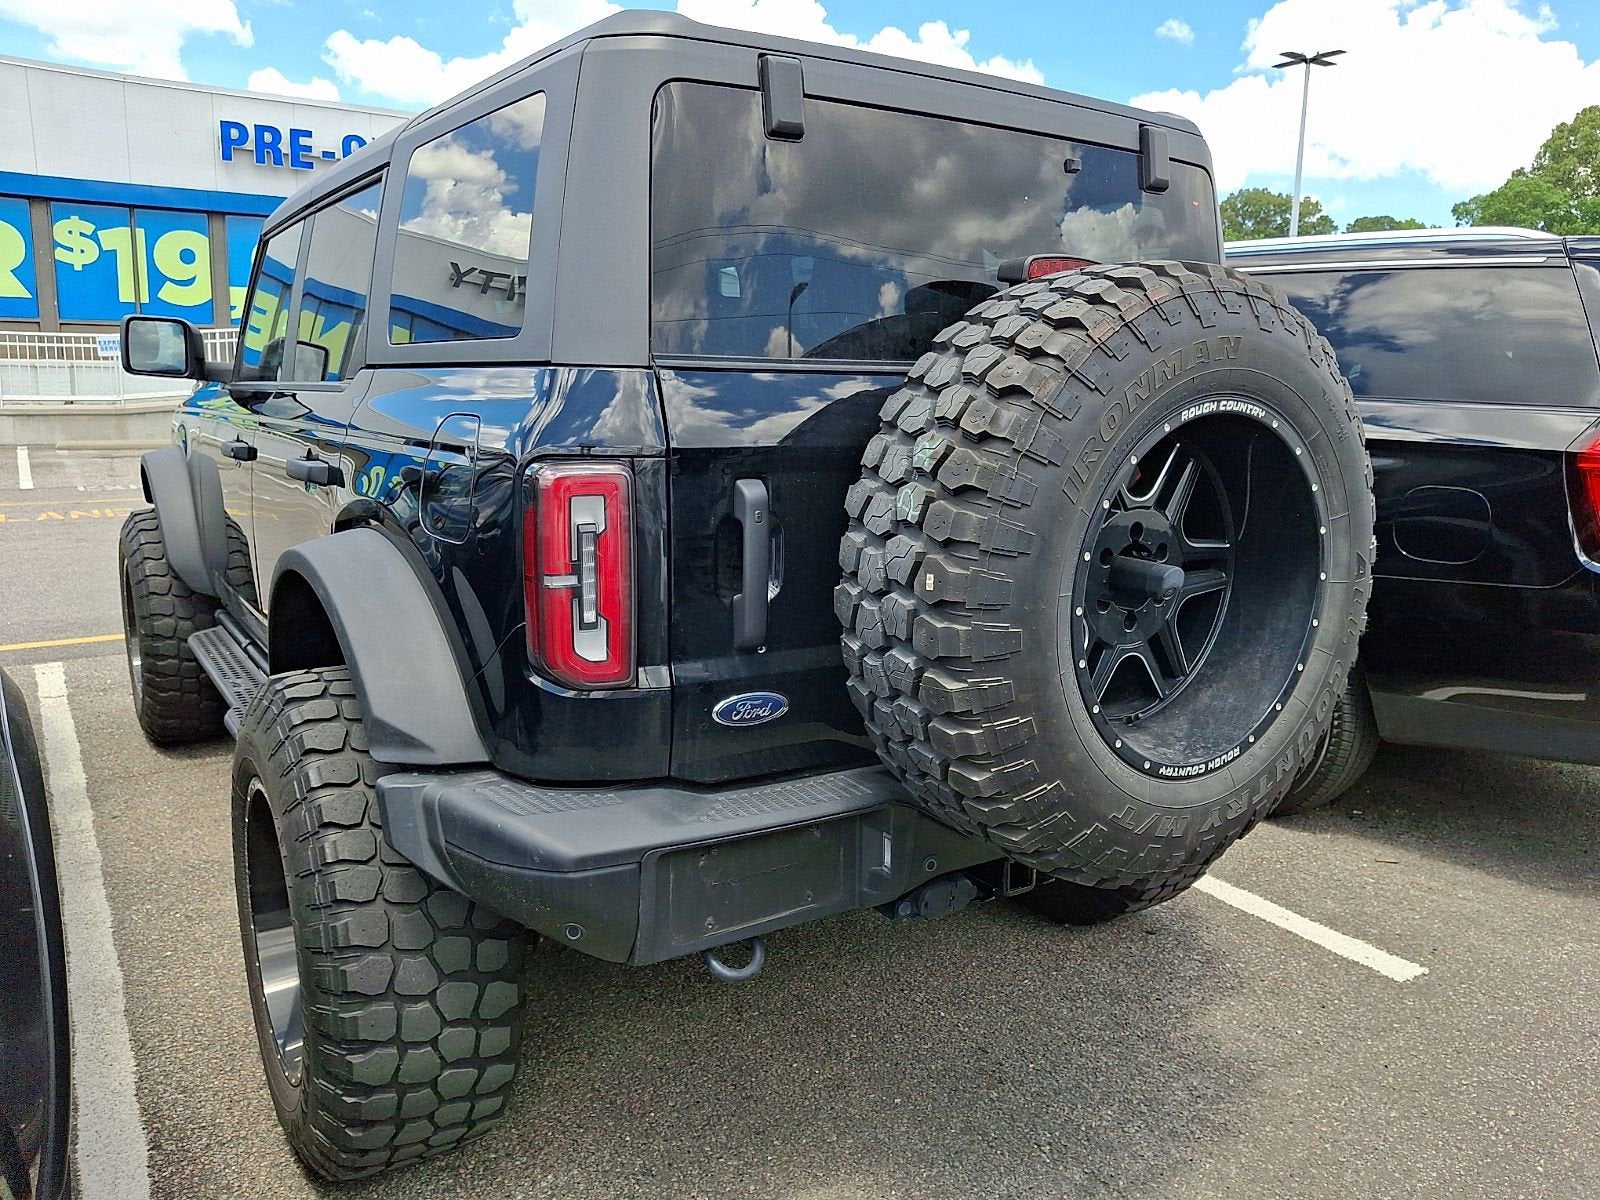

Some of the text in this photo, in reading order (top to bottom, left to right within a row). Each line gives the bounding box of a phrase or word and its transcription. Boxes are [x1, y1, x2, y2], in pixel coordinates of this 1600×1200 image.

[1061, 335, 1243, 505] IRONMAN
[1180, 399, 1267, 422] ROUGH COUNTRY
[731, 699, 773, 721] Ford
[1198, 659, 1346, 834] COUNTRY
[1207, 745, 1241, 772] ROUGH
[1158, 761, 1206, 778] COUNTRY
[1108, 805, 1192, 838] M/T
